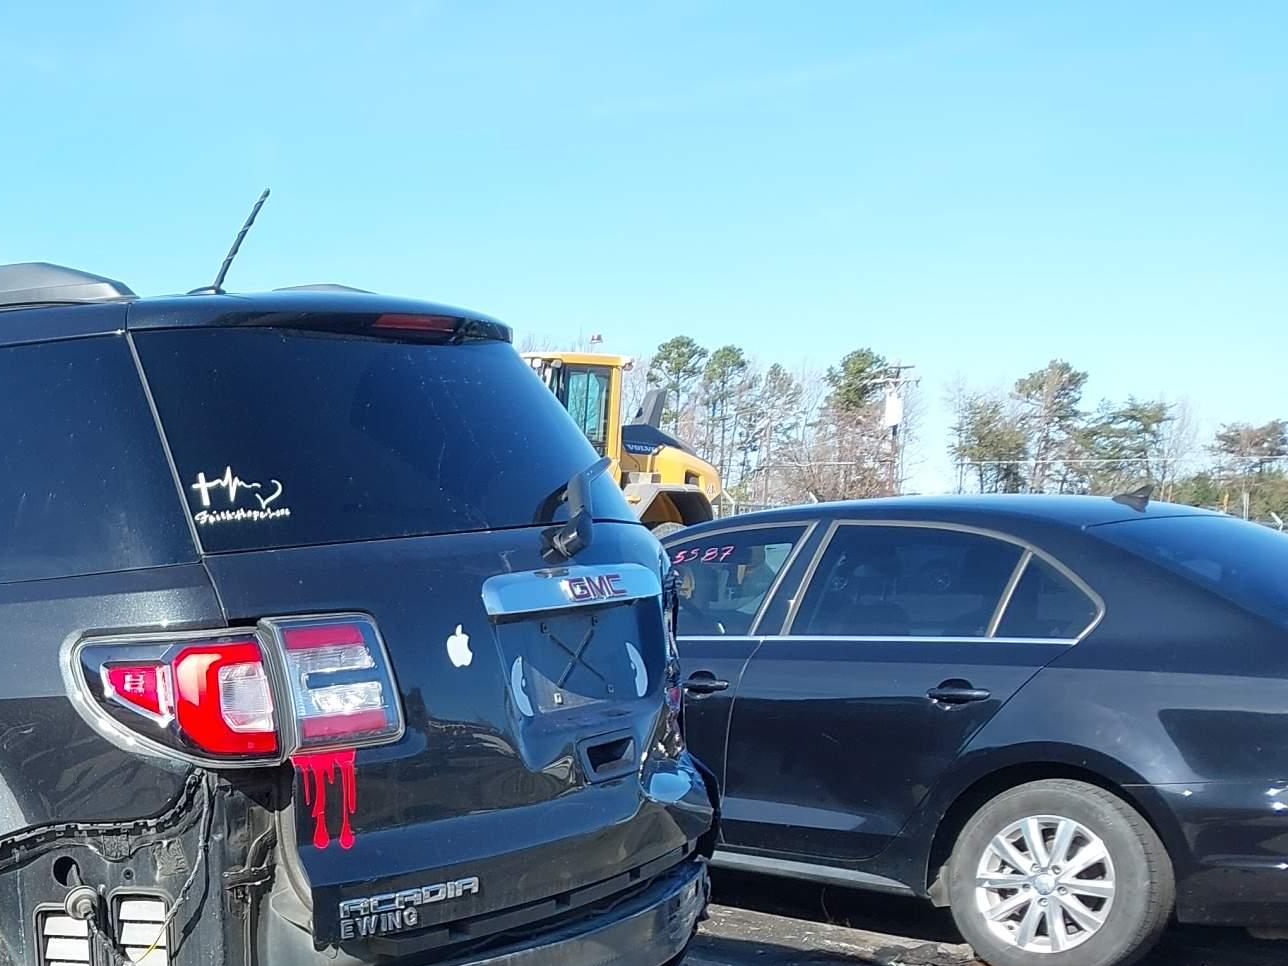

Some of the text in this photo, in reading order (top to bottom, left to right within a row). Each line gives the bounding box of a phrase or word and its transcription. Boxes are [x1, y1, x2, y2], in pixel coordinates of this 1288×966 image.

[672, 545, 734, 564] 5587
[567, 574, 627, 601] GMC
[339, 876, 480, 918] ACADIA
[341, 907, 418, 940] EWING
